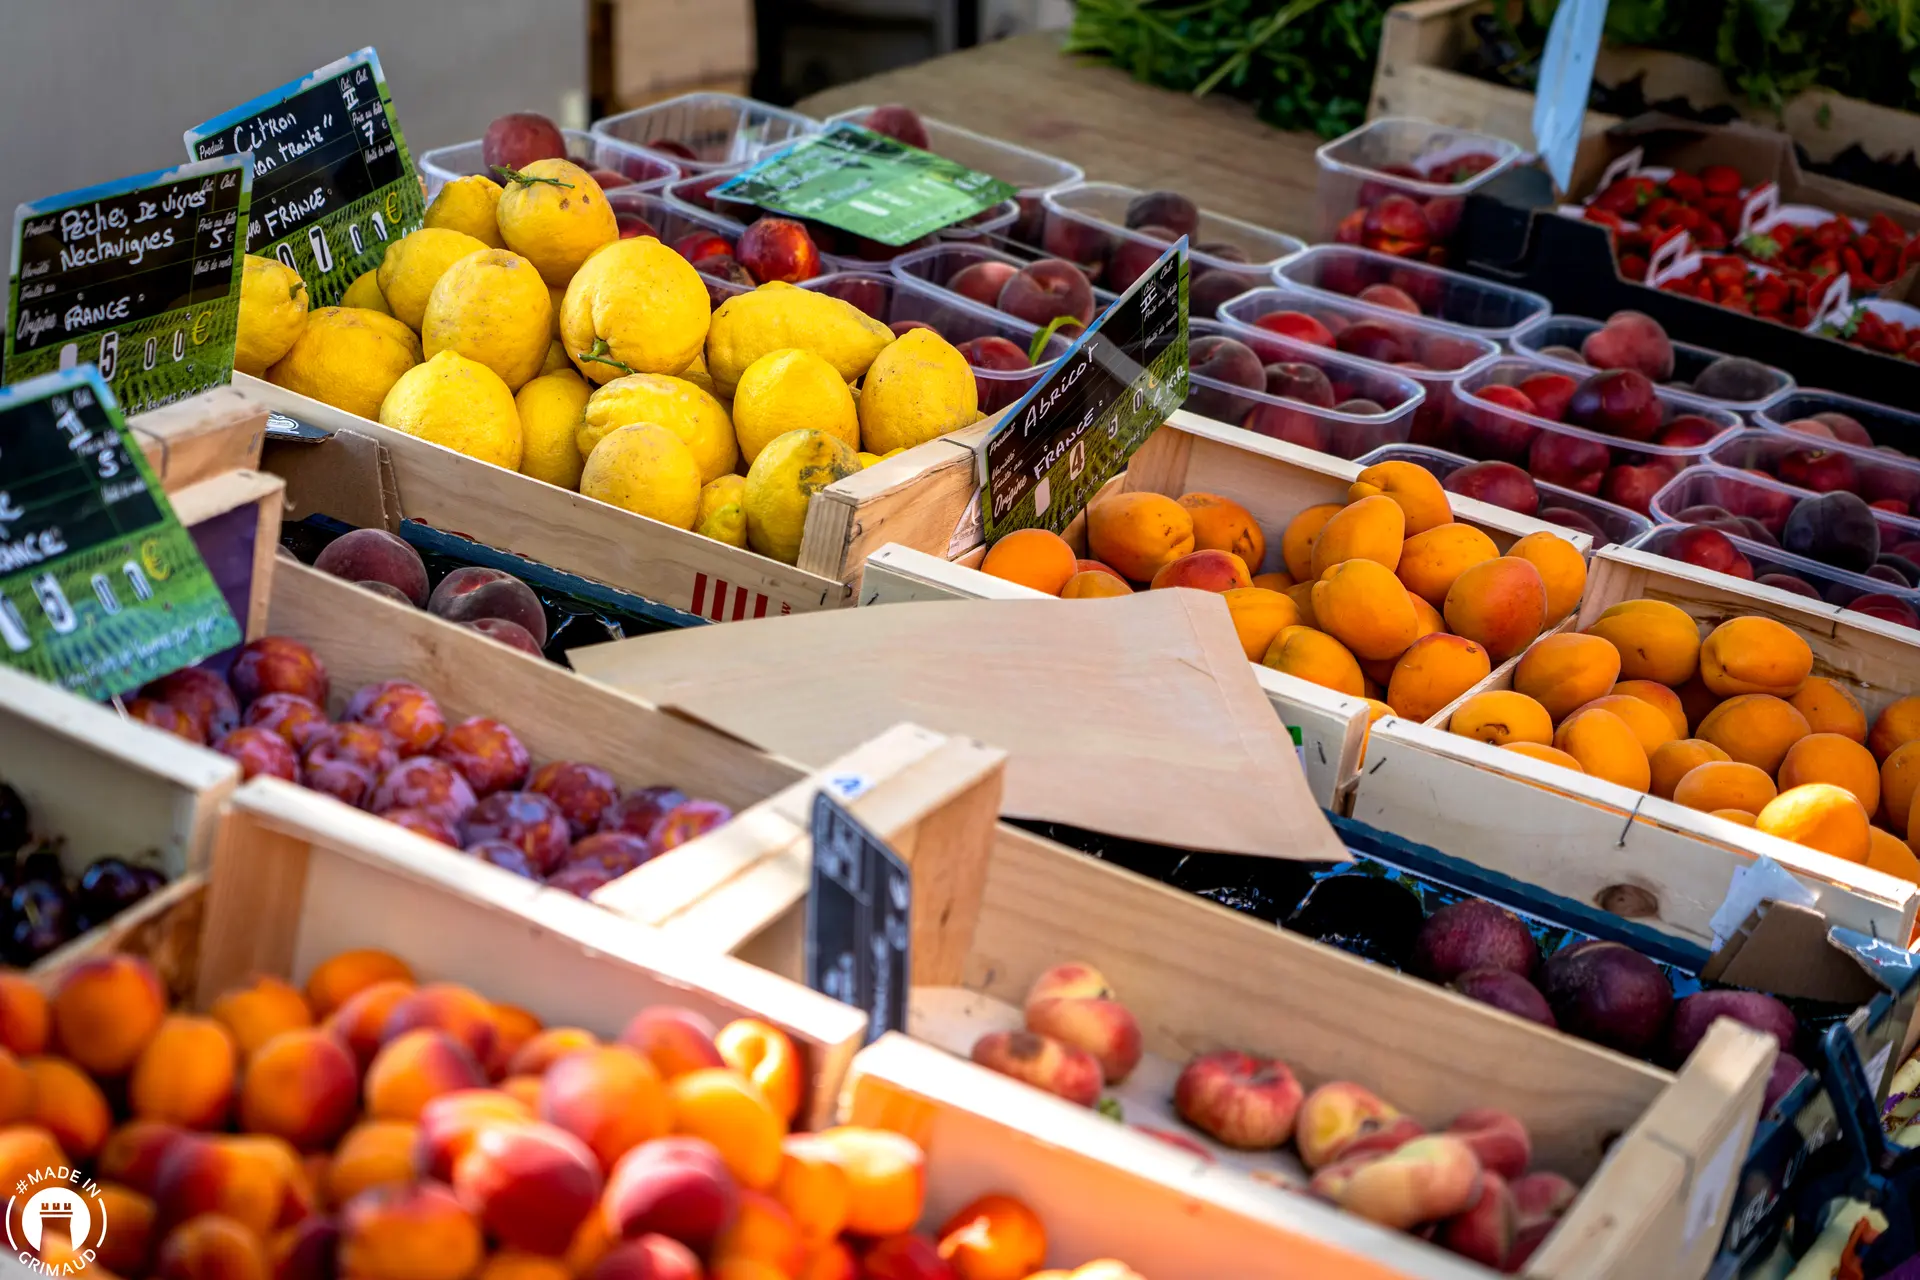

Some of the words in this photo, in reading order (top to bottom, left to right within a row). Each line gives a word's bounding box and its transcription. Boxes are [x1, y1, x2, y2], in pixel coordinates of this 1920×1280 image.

[199, 138, 224, 160] Produit
[362, 120, 374, 146] 7
[24, 218, 56, 238] Produit
[264, 187, 326, 237] FRANCE
[17, 308, 57, 347] Origine
[64, 297, 130, 331] FRANCE
[989, 422, 1016, 456] Produit
[994, 475, 1027, 518] Origine
[1034, 408, 1094, 480] FRANCE
